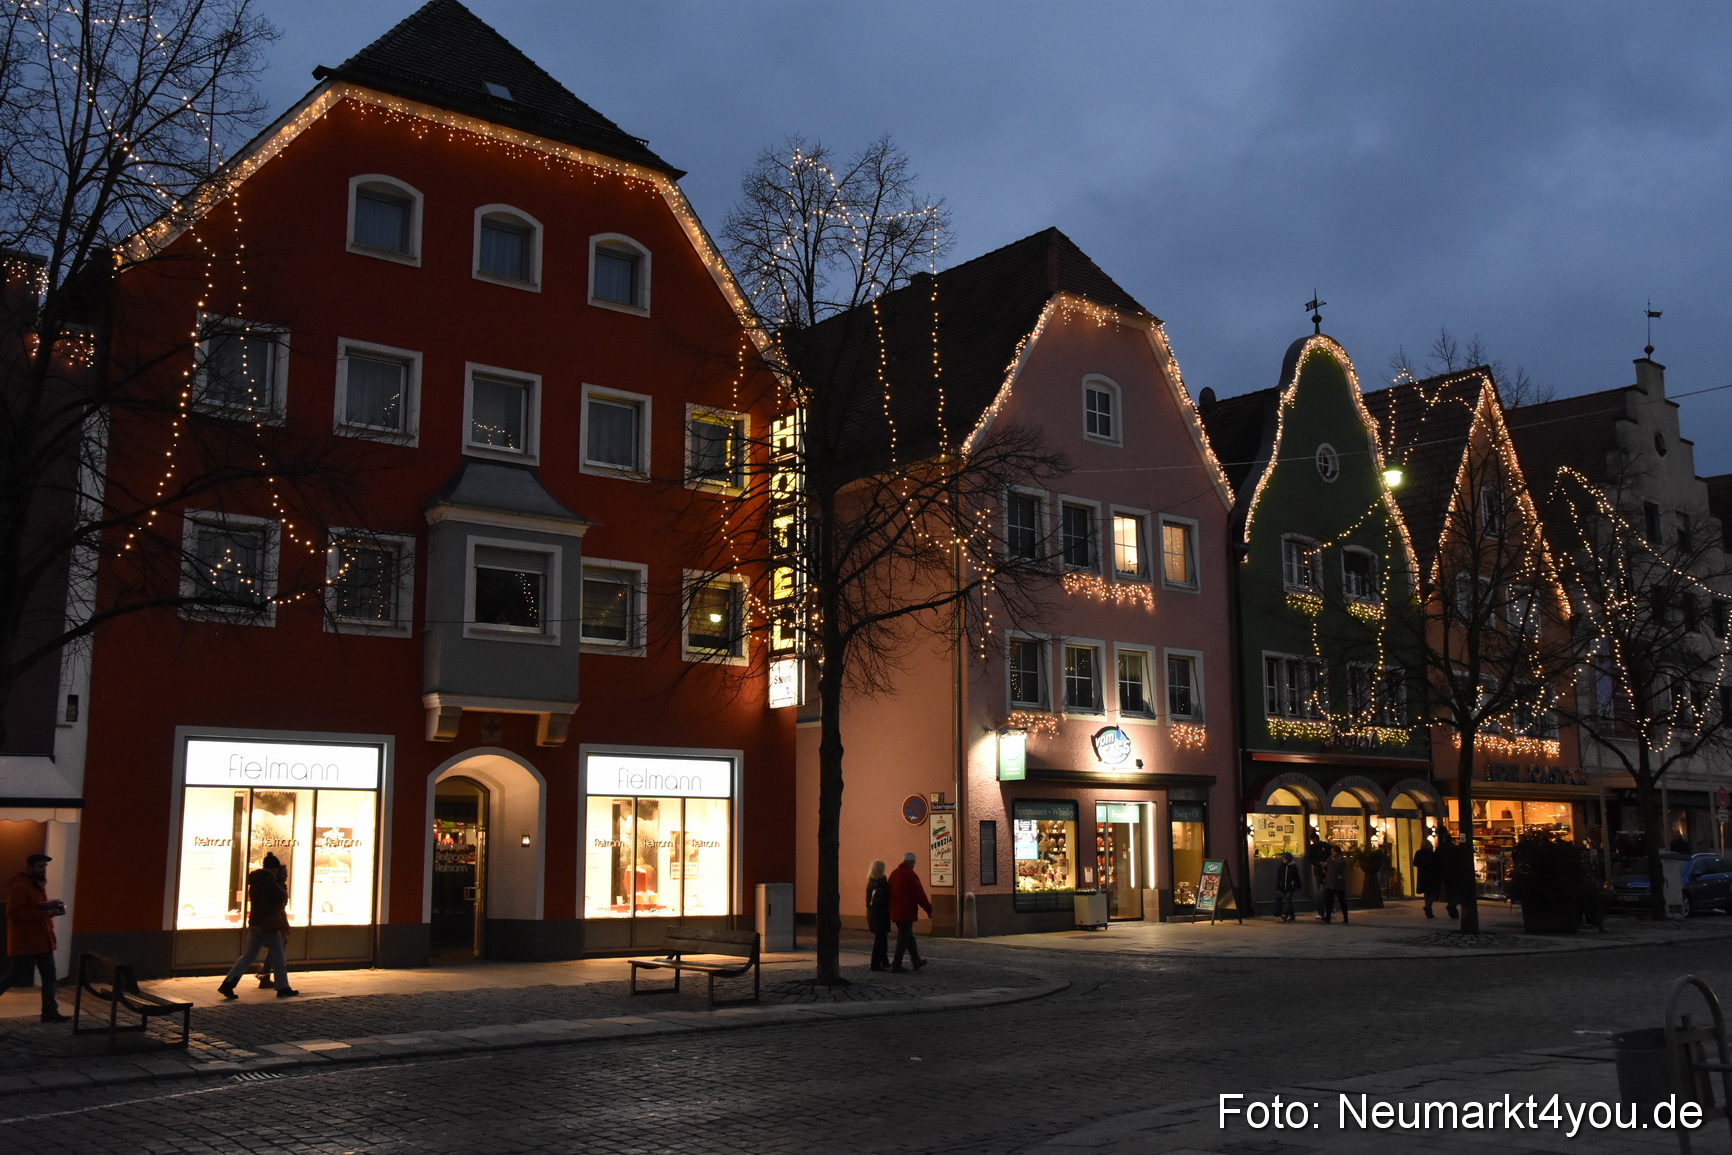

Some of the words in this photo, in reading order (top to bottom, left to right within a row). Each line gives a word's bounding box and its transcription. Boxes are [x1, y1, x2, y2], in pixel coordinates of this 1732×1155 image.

[772, 414, 795, 651] HOTEL
[1095, 733, 1115, 748] vom
[229, 753, 339, 781] fielmann
[618, 767, 702, 791] fielmann
[1015, 806, 1048, 817] Spirituosen
[1052, 808, 1074, 818] Whisky
[931, 836, 952, 850] VENEZIA
